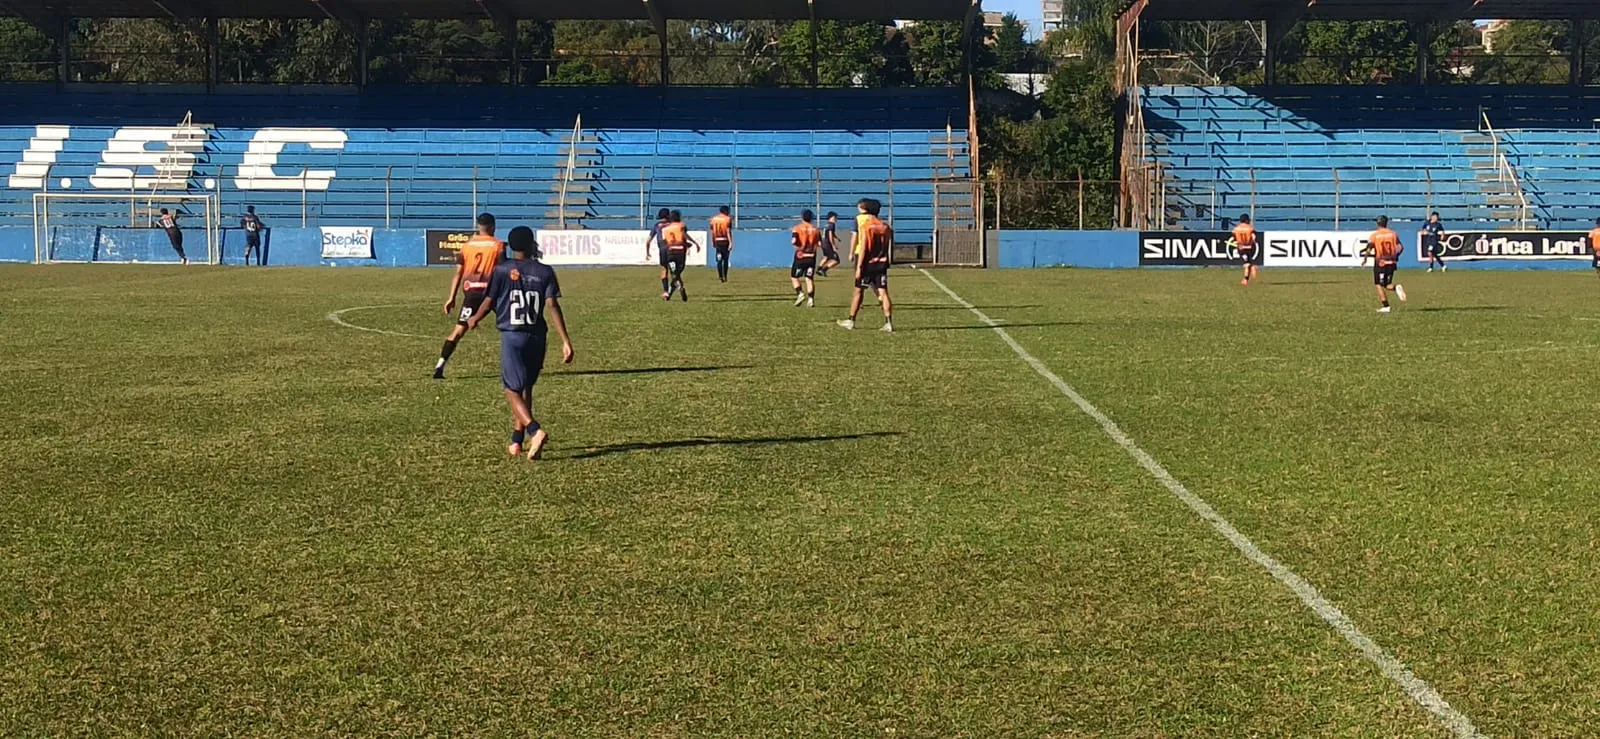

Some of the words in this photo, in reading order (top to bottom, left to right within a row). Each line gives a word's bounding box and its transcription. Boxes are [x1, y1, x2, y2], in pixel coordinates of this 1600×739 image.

[323, 233, 368, 248] Stepka
[474, 252, 484, 274] 2
[510, 289, 540, 325] 20
